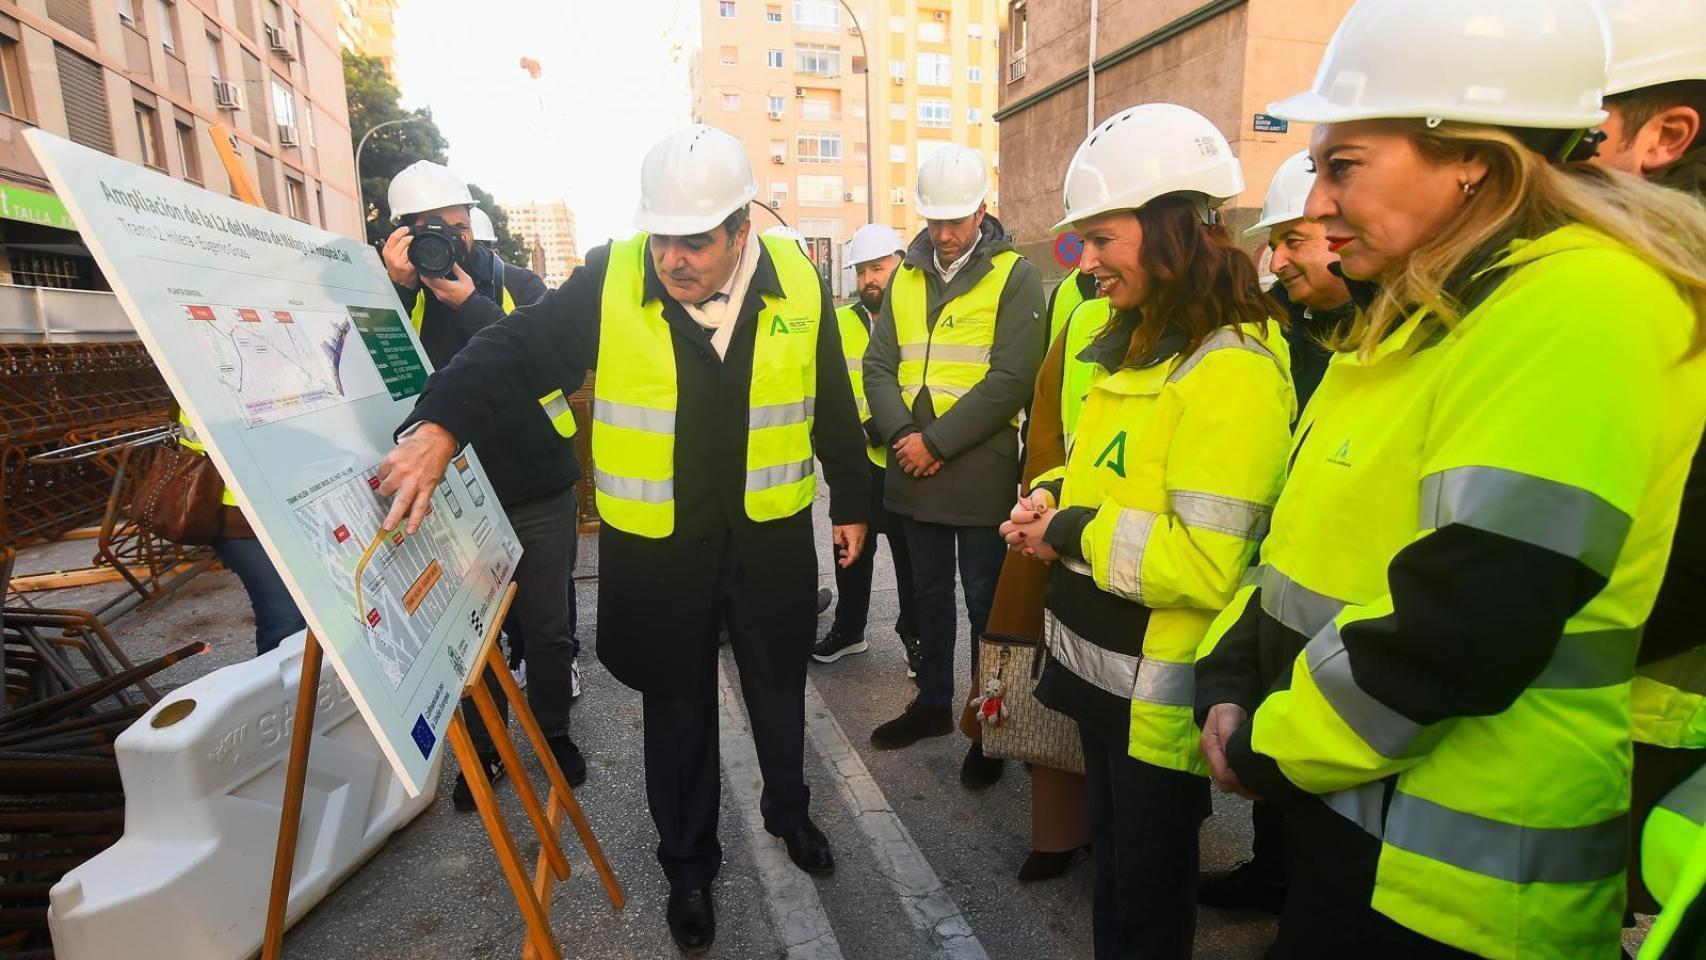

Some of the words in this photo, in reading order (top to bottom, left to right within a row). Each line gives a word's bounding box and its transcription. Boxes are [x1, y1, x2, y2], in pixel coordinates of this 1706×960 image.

[12, 204, 52, 226] TALLA
[99, 180, 187, 222] Ampliación
[184, 204, 201, 226] de
[197, 208, 213, 229] la
[210, 213, 229, 234] L2
[226, 216, 243, 238] del
[241, 221, 272, 243] Metro
[117, 217, 158, 240] Tramo
